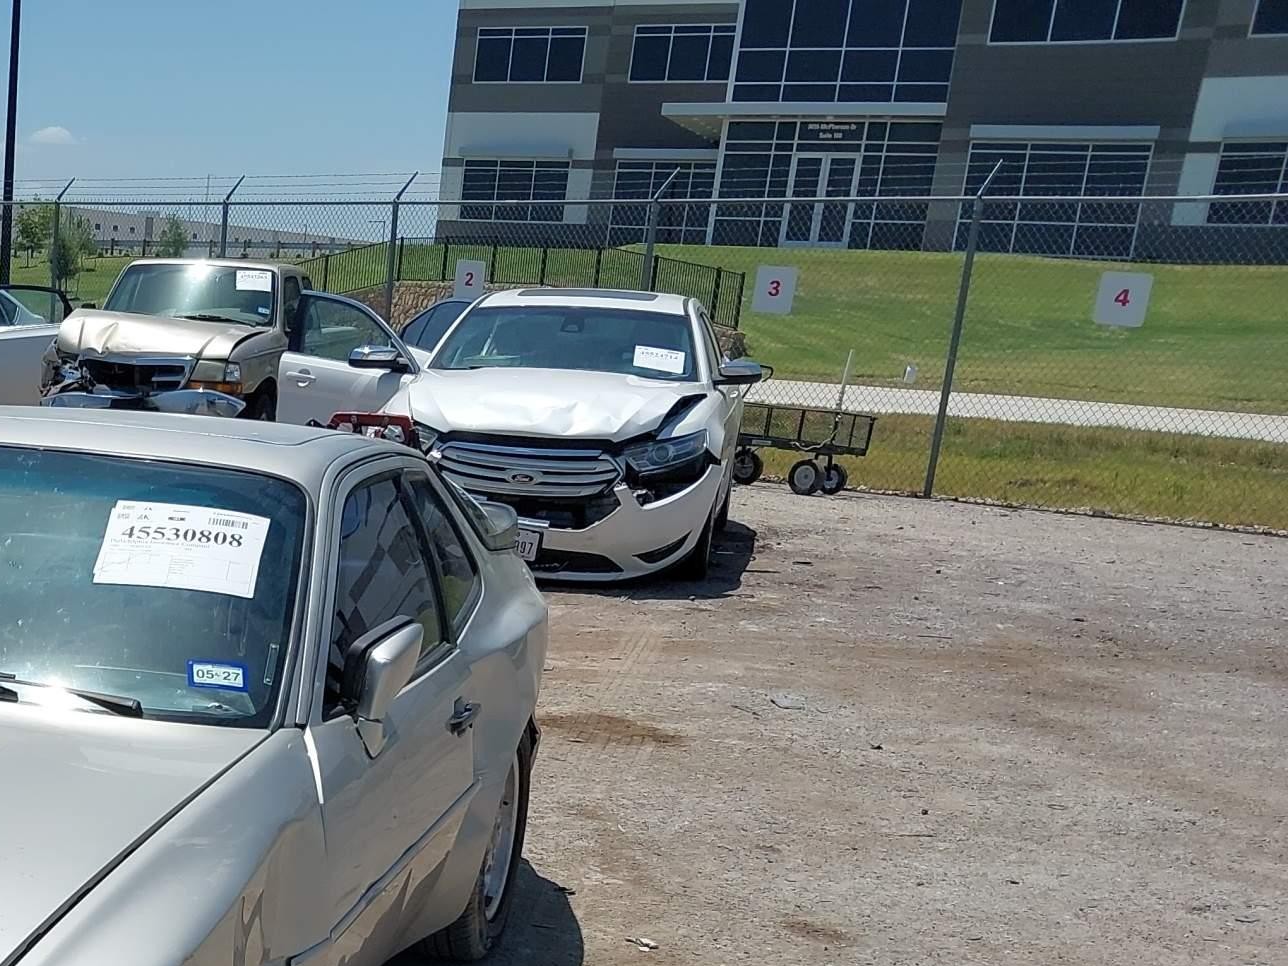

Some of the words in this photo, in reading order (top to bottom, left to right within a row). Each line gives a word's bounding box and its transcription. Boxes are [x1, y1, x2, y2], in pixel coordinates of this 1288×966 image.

[465, 272, 474, 287] 2
[767, 280, 781, 297] 3
[1114, 288, 1130, 307] 4
[121, 524, 244, 548] 45530808
